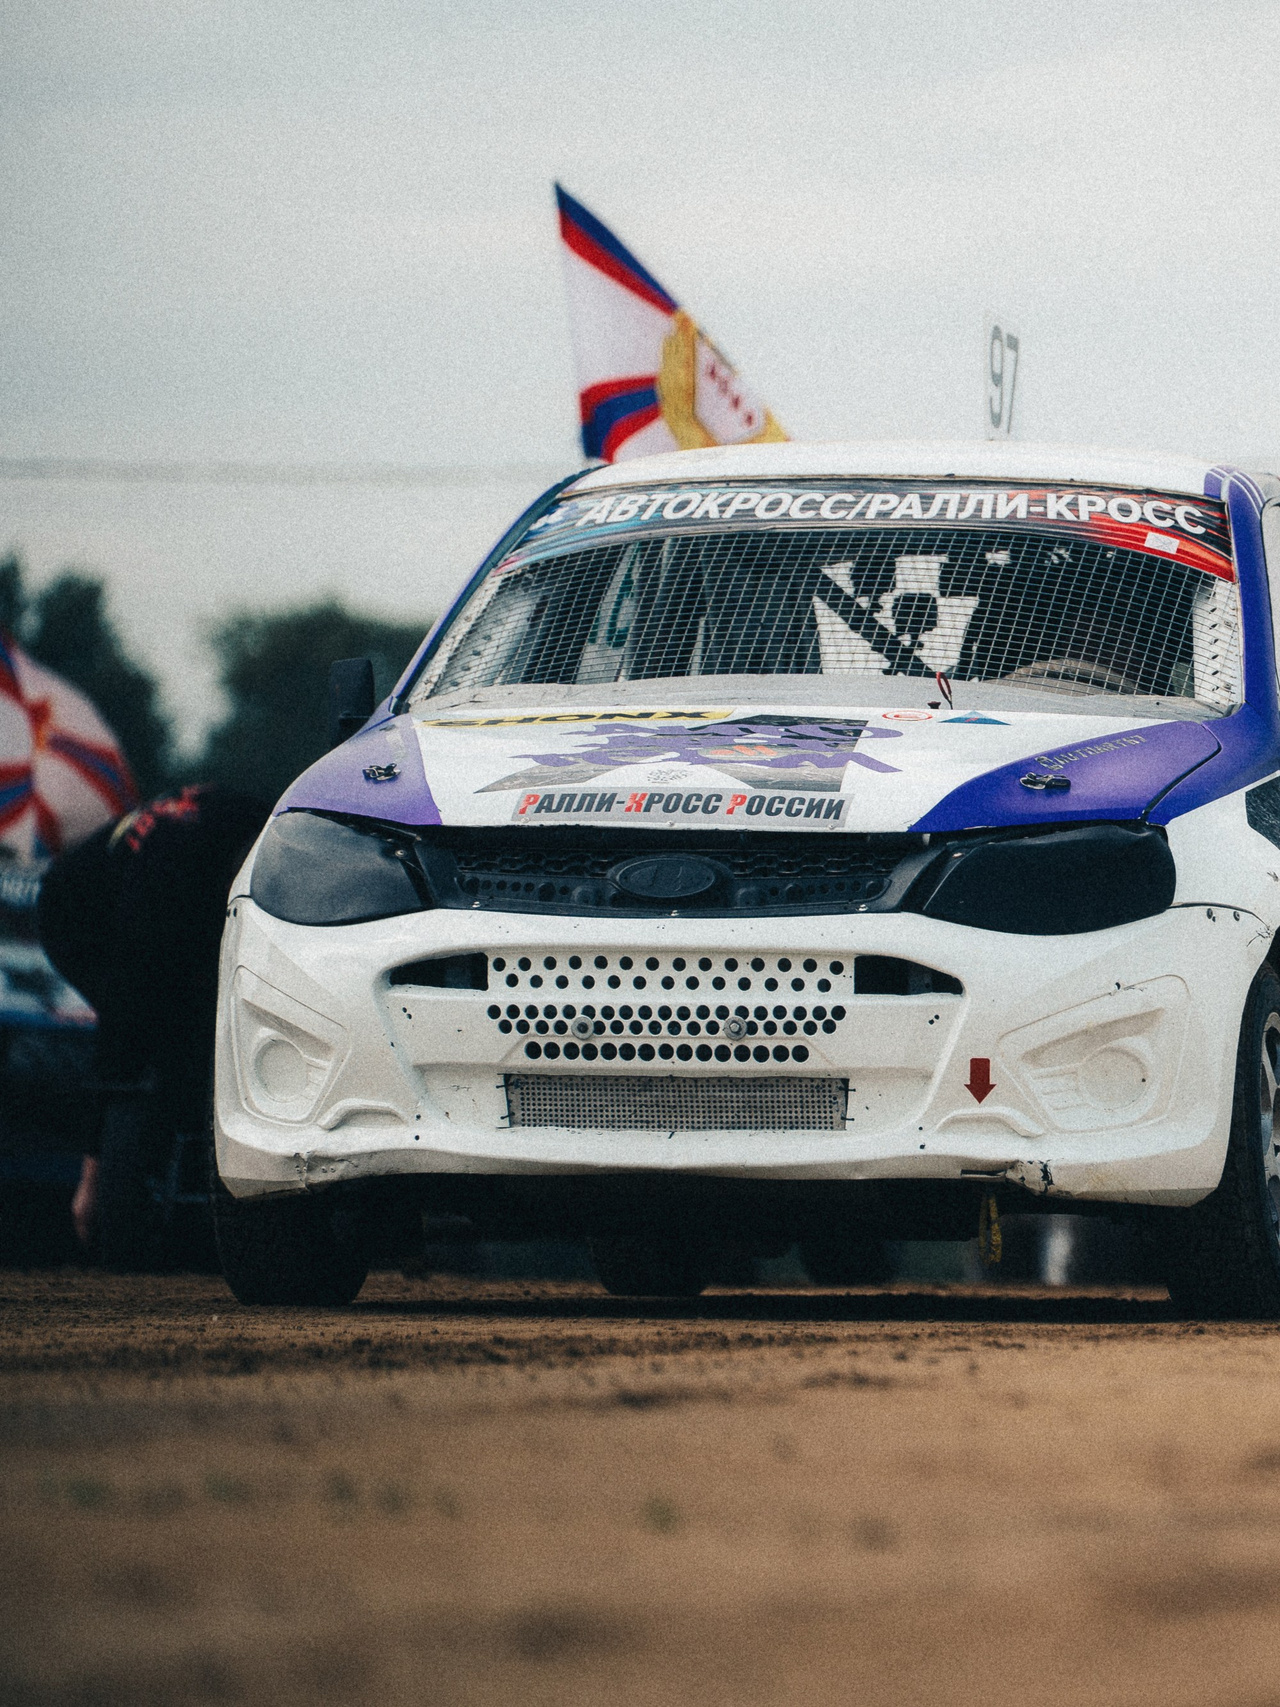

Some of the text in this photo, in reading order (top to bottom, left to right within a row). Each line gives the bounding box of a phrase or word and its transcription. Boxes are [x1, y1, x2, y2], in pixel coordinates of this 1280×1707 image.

[988, 325, 1020, 434] 97
[575, 489, 1208, 535] АВТОКРОСС/РАЛЛИ-КРОСС
[518, 792, 846, 820] РАЛЛИ-КРОСС РОССИИ
